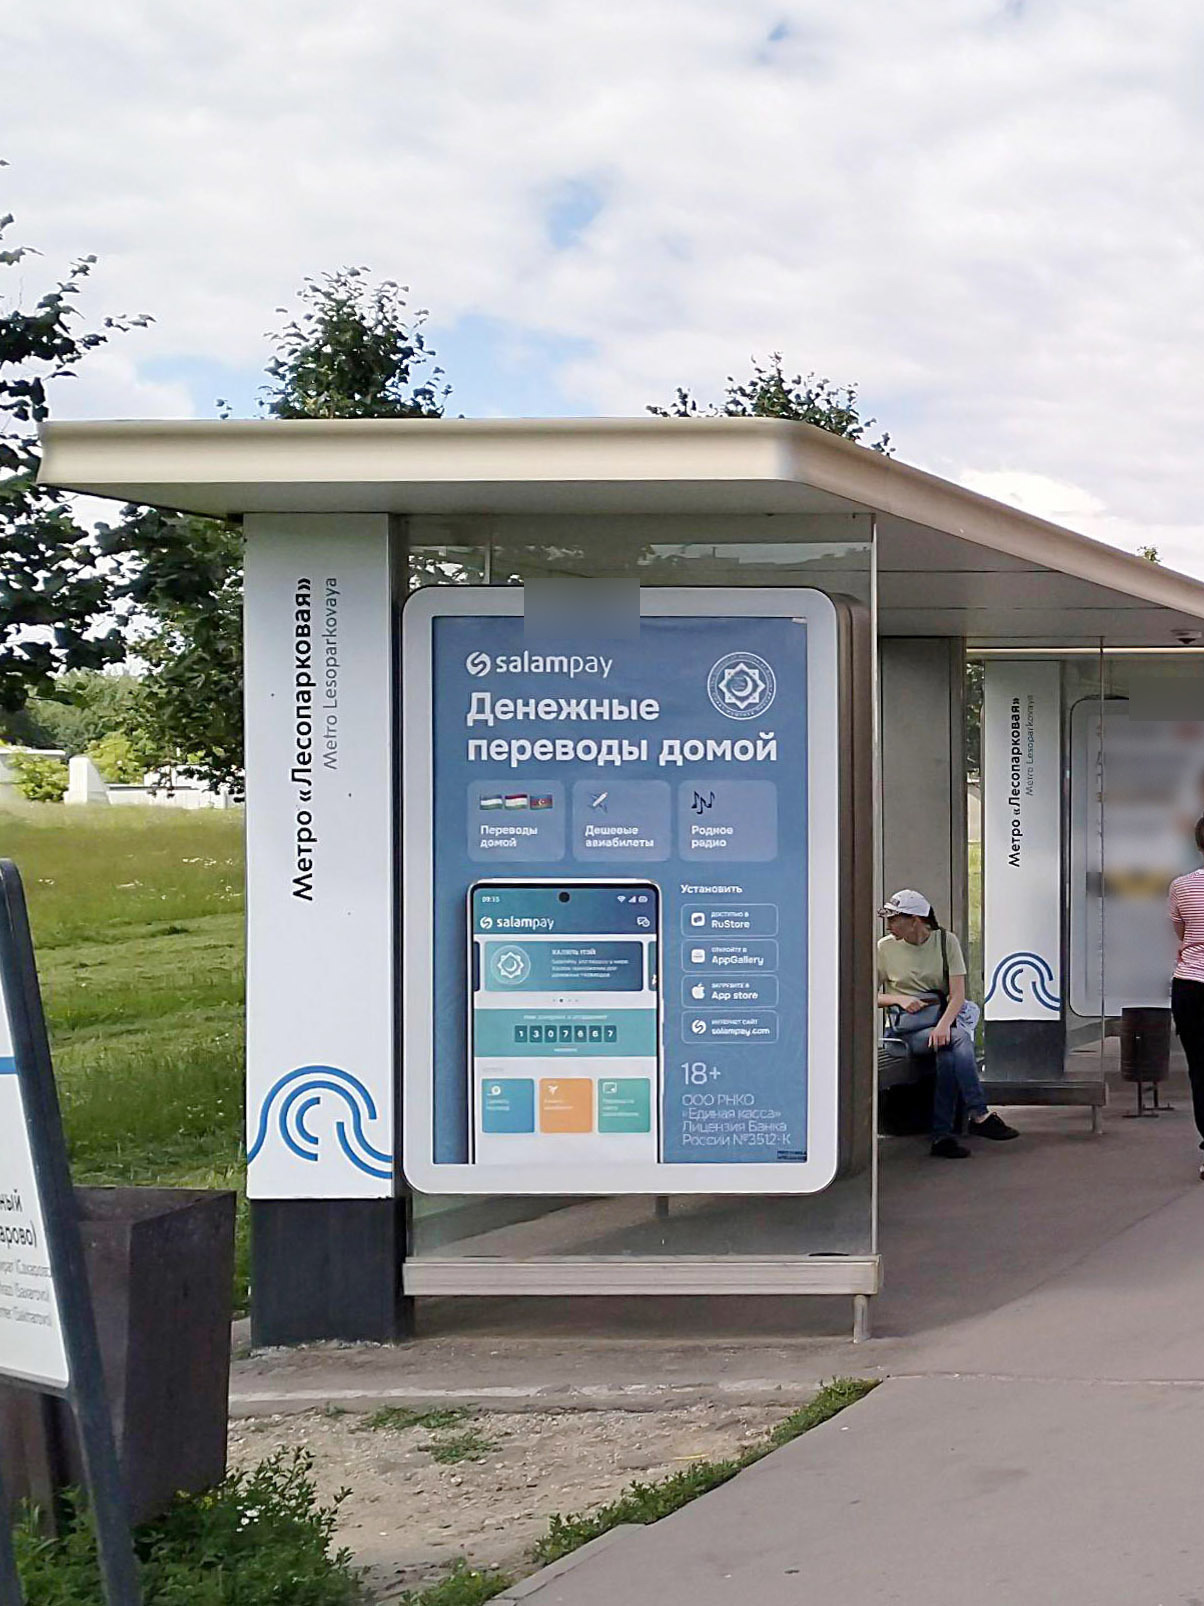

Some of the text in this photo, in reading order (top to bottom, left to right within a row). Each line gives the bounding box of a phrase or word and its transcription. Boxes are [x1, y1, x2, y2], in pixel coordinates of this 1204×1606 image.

[495, 650, 613, 679] salampay
[321, 577, 341, 770] Metro Lesoparkovaya
[466, 692, 660, 727] Денежные
[291, 577, 318, 902] Метро «Лесопарковая»
[467, 731, 778, 768] переводы домой
[1008, 697, 1024, 868] Метро «Лесопарковая»
[480, 825, 538, 836] Переводы
[584, 825, 639, 837] Дешевые
[691, 825, 734, 837] Родное
[480, 837, 517, 849] домой
[585, 837, 655, 848] авиабилеты
[691, 837, 727, 849] радио
[680, 884, 743, 894] Установить
[496, 915, 554, 930] salampay
[711, 919, 751, 929] RuStore
[711, 955, 764, 966] AppGallery
[711, 990, 758, 1001] App store
[681, 1061, 721, 1085] 18+
[681, 1093, 755, 1106] ООО РНКО
[681, 1108, 782, 1121] «Единая касса»
[682, 1120, 788, 1134] Лицензия Банка
[682, 1134, 731, 1146] России
